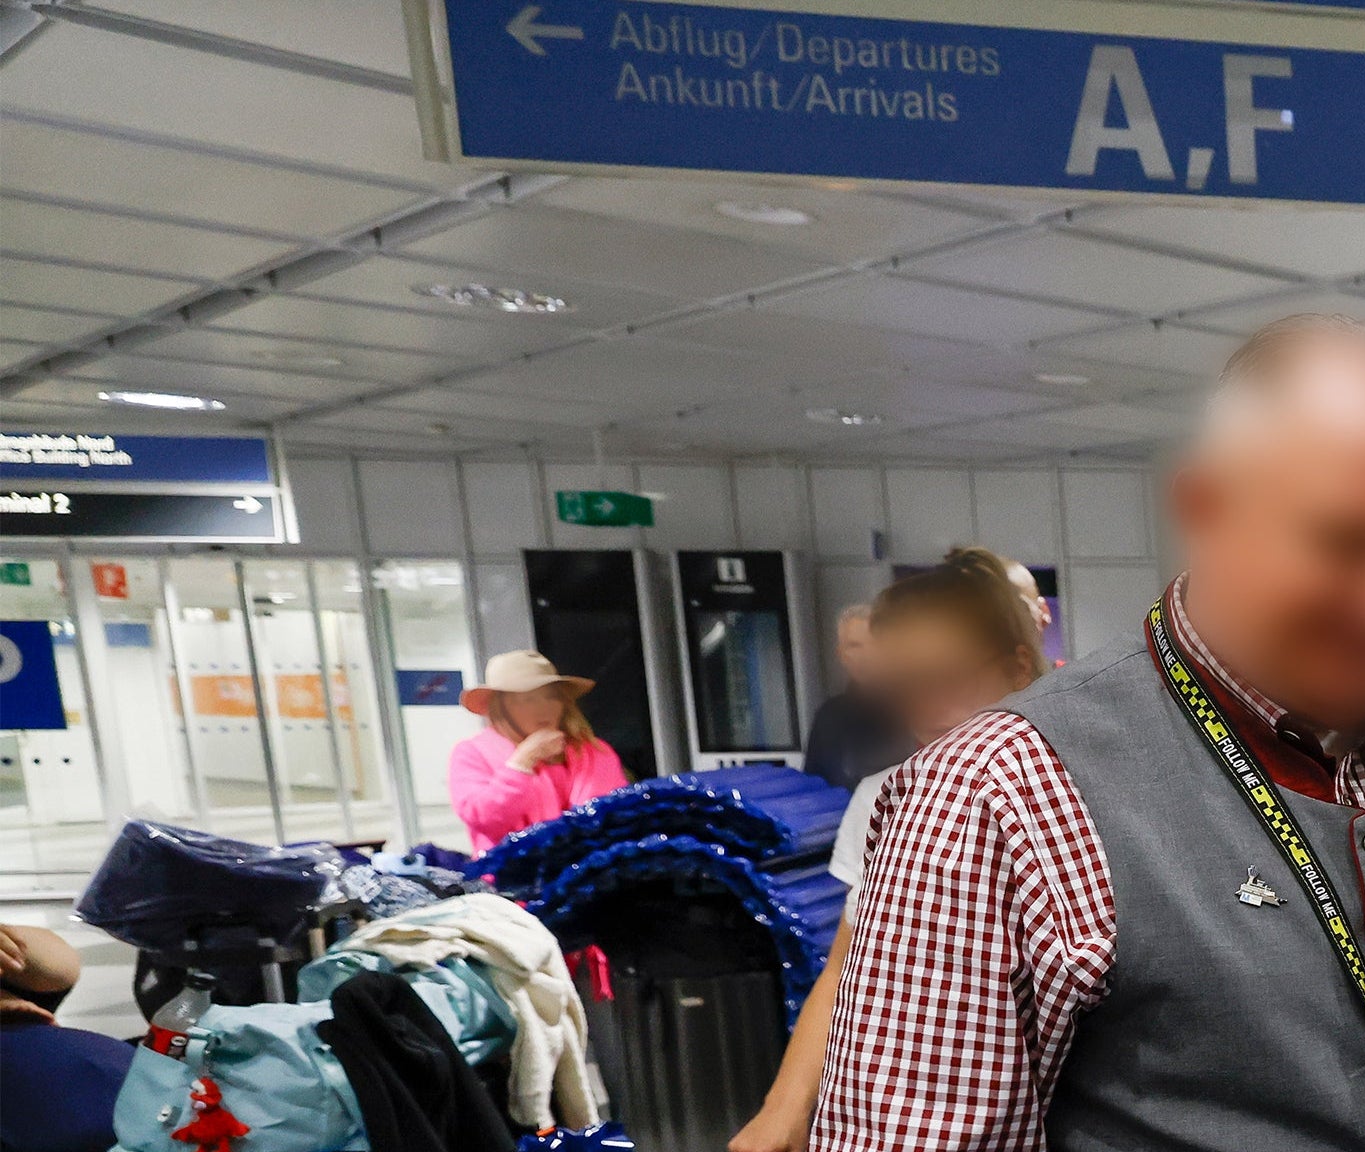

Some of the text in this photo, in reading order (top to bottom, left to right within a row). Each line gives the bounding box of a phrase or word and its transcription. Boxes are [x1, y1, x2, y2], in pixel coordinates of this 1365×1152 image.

[609, 11, 999, 77] Abflug/Departures
[614, 62, 958, 121] Ankunft/Arrivals
[1066, 44, 1294, 191] A,F
[1153, 621, 1177, 668] FOLLOW ME
[1218, 738, 1261, 789] FOLLOW ME
[1301, 865, 1337, 919] FOLLOW ME
